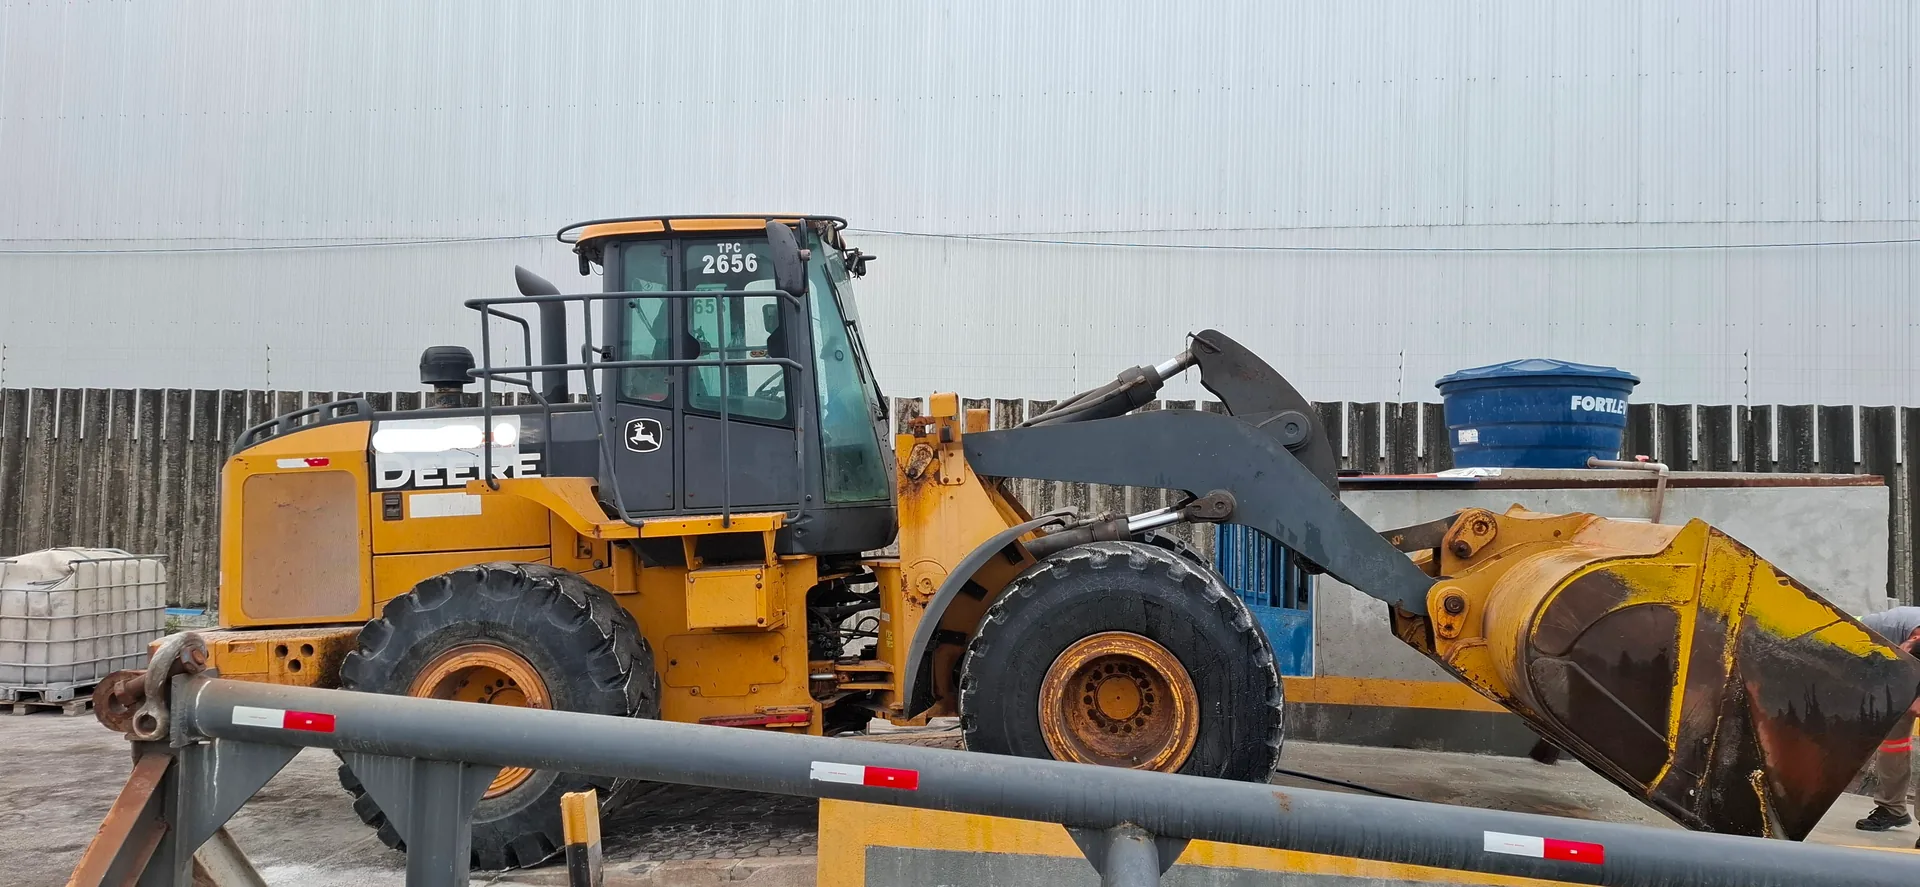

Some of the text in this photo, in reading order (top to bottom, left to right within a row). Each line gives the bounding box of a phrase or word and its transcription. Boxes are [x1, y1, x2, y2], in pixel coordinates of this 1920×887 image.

[717, 243, 741, 253] TPC
[702, 253, 758, 274] 2656
[376, 452, 541, 489] DEERE
